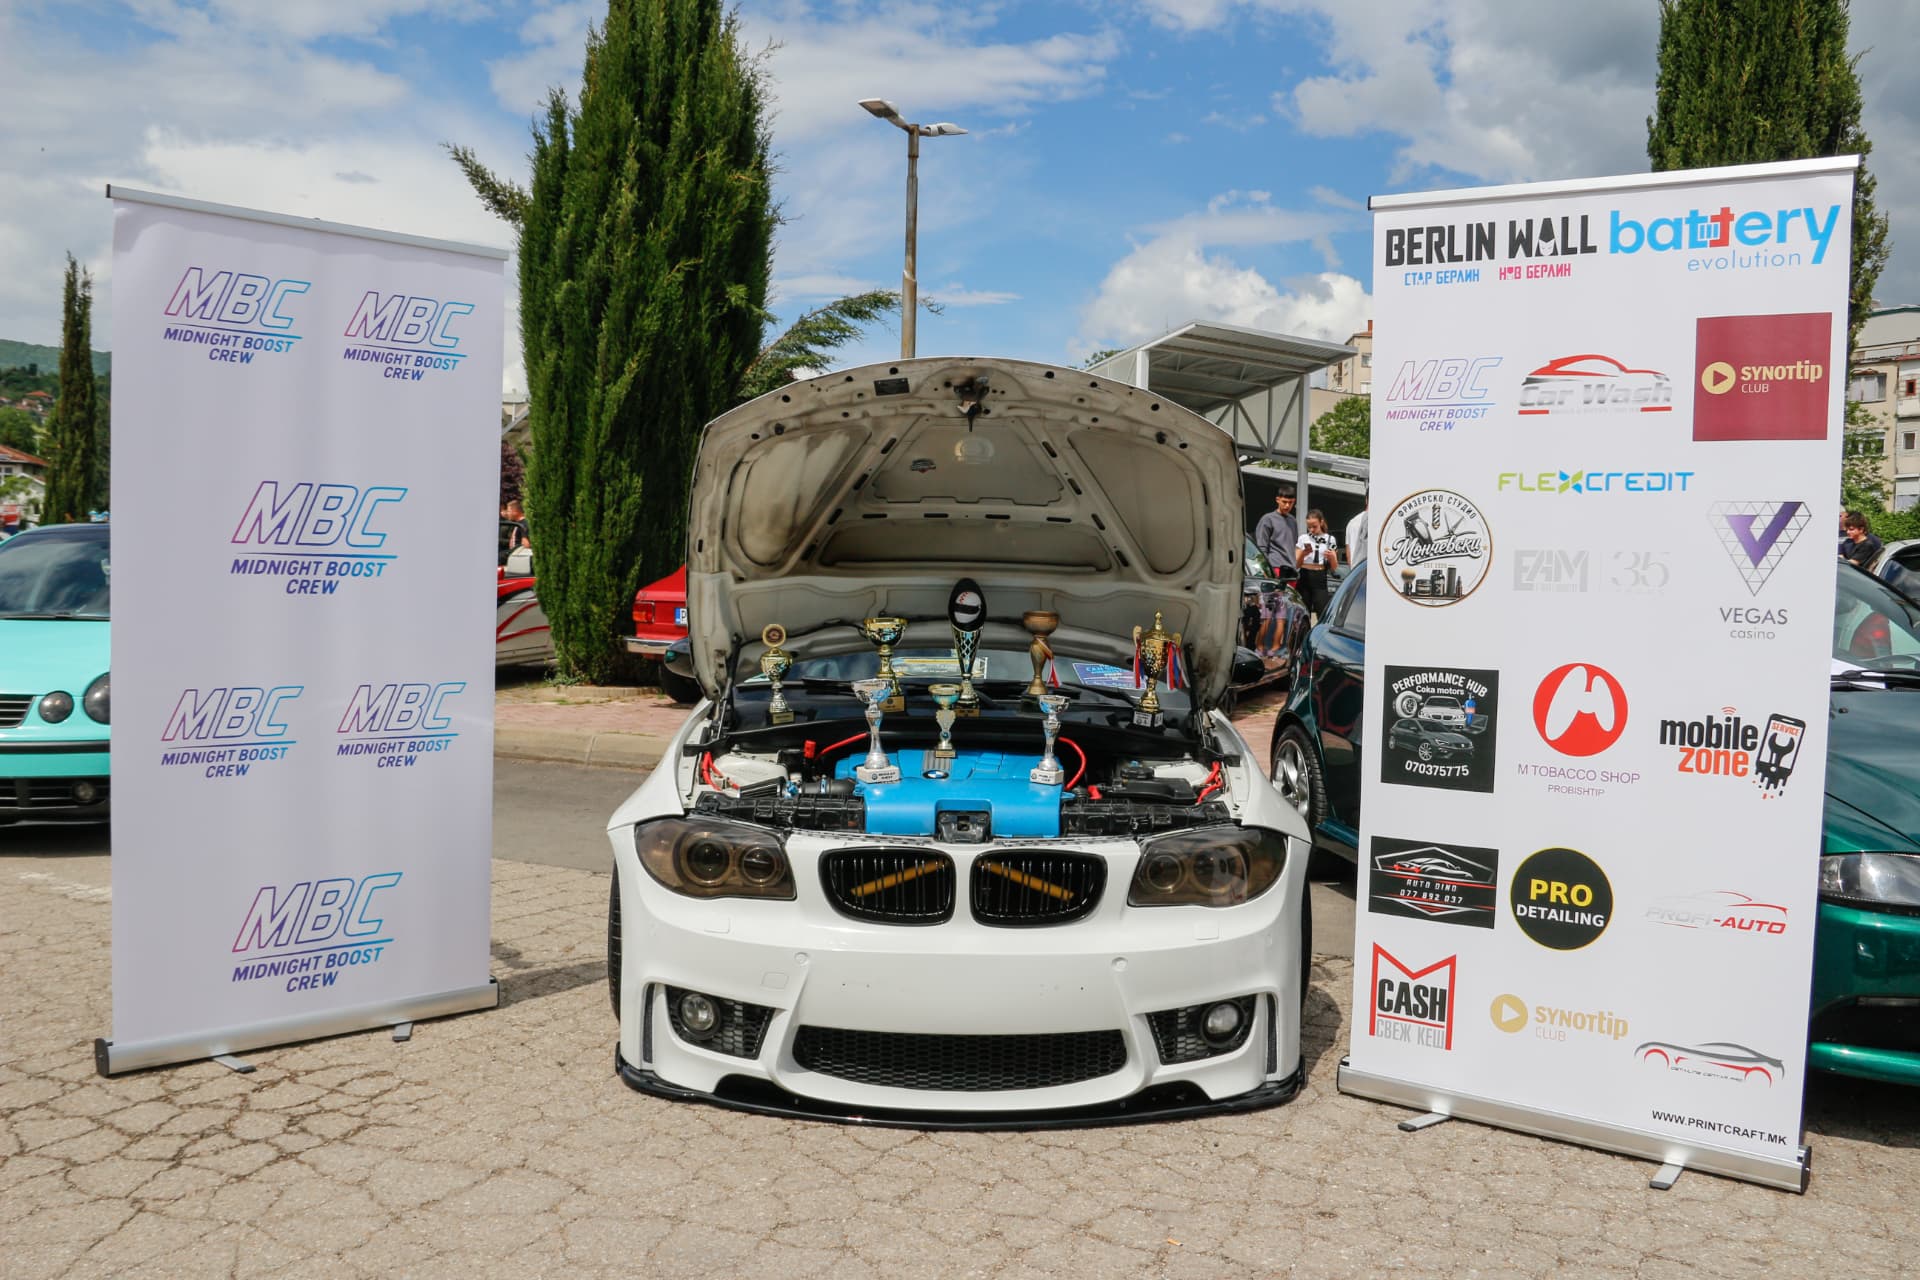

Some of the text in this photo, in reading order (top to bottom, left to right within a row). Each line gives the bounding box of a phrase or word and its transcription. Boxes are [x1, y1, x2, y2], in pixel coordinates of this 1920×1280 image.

[1385, 214, 1598, 267] BERLIN WALL
[1526, 263, 1571, 279] БЕРЛИН
[1687, 249, 1800, 271] evolution
[1436, 269, 1480, 285] БЕРЛИН
[164, 267, 311, 329] MBC
[344, 291, 474, 348] MBC
[164, 327, 294, 353] MIDNIGHT BOOST
[209, 348, 254, 364] CREW
[343, 347, 459, 371] MIDNIGHT BOOST
[384, 366, 424, 381] CREW
[1386, 357, 1503, 401] MBC
[1520, 383, 1672, 406] Car Wash
[1741, 383, 1769, 394] CLUB
[1386, 408, 1488, 420] MIDNIGHT BOOST
[1420, 421, 1455, 431] CREW
[231, 480, 408, 547] MBC
[1398, 495, 1477, 519] ФРИЗЕРСКО СТУДИО
[231, 559, 387, 577] MIDNIGHT BOOST
[286, 579, 339, 595] CREW
[1719, 606, 1789, 626] VEGAS
[1730, 627, 1775, 640] casino
[1392, 672, 1488, 697] PERFORMANCE HUB
[1416, 685, 1464, 695] Coka motors
[161, 686, 304, 741] MBC
[337, 682, 466, 733] MBC
[1660, 715, 1758, 751] mobile
[1771, 721, 1800, 736] SERVICE
[161, 746, 288, 766] MIDNIGHT BOOST
[337, 739, 451, 756] MIDNIGHT BOOST
[205, 764, 249, 778] CREW
[377, 754, 417, 768] CREW
[1405, 760, 1469, 777] 070375775
[1678, 747, 1749, 778] zone
[1518, 764, 1640, 784] M TOBACCO SHOP
[1548, 784, 1605, 797] PROBISHTIP
[1400, 889, 1463, 904] 077 892 037
[1406, 879, 1457, 892] AUTO DINO
[1530, 878, 1593, 907] PRO
[232, 872, 403, 952] MBC
[1516, 904, 1605, 927] DETAILING
[1644, 907, 1787, 935] PROFI-AUTO
[232, 947, 384, 982] MIDNIGHT BOOST
[286, 971, 339, 993] CREW
[1378, 978, 1447, 1023] CASH
[1376, 1018, 1445, 1049] СВЕЖ КЕШ
[1535, 1026, 1566, 1042] CLUB
[1652, 1110, 1788, 1146] WWW.PRINTCRAFT.MK
